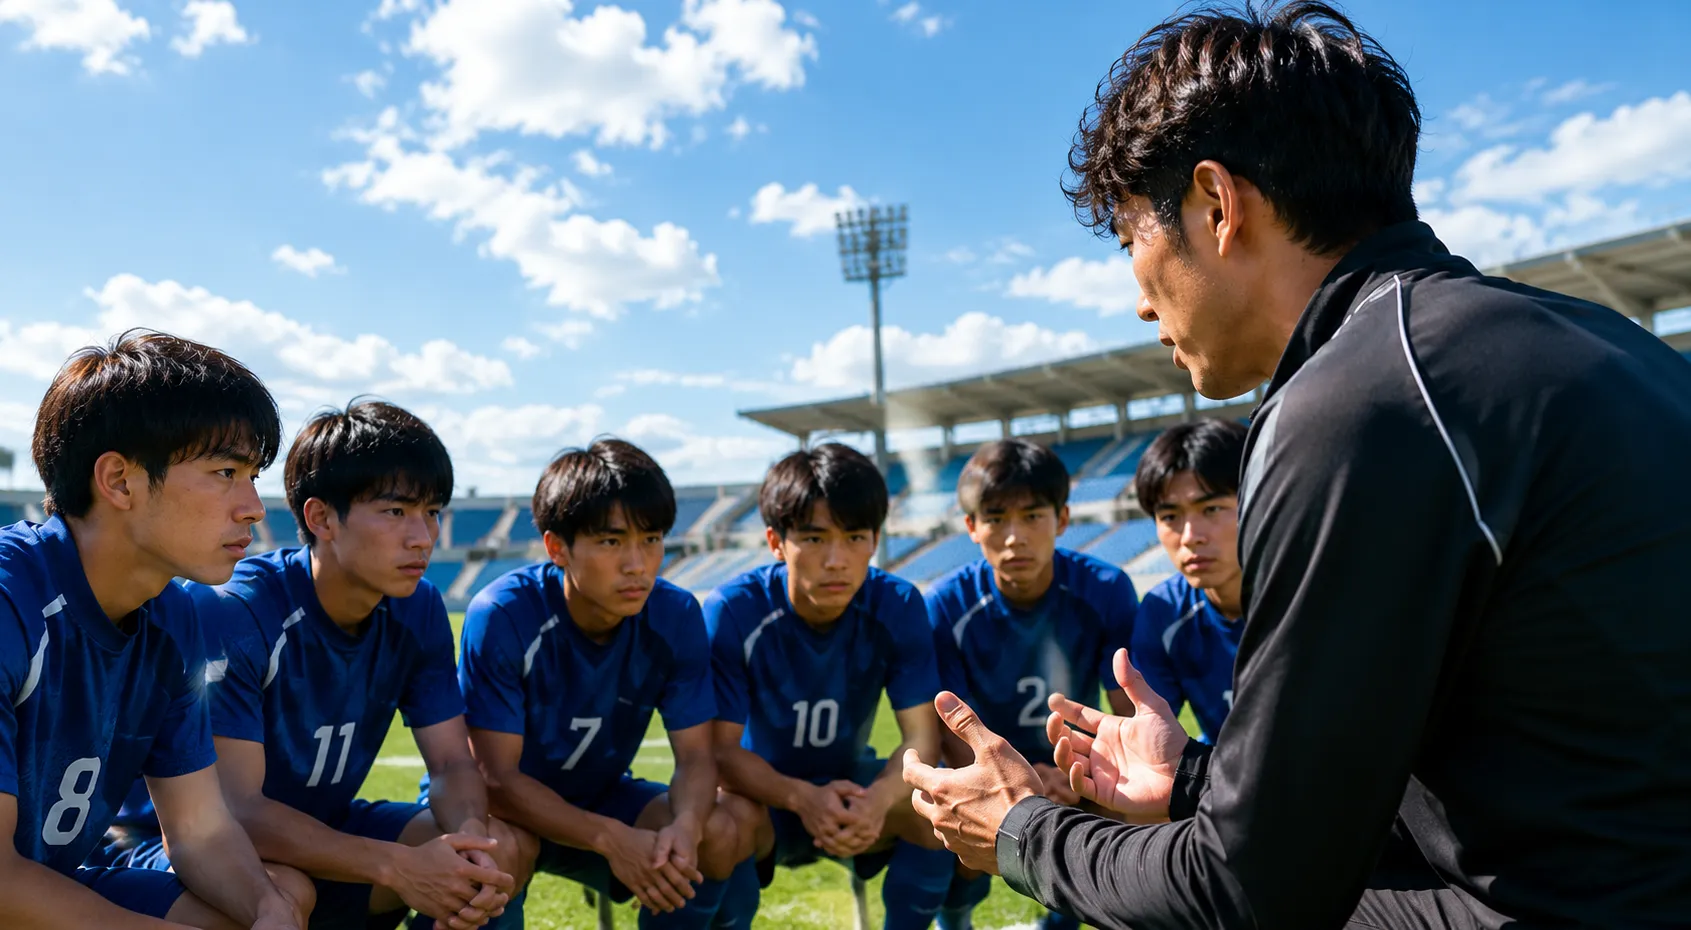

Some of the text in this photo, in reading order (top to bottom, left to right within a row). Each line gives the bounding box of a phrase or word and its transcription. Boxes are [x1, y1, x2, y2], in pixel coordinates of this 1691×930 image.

[792, 699, 839, 747] 10
[1017, 676, 1047, 726] 2
[306, 722, 356, 787] 11
[561, 717, 602, 770] 7
[42, 756, 101, 845] 8
